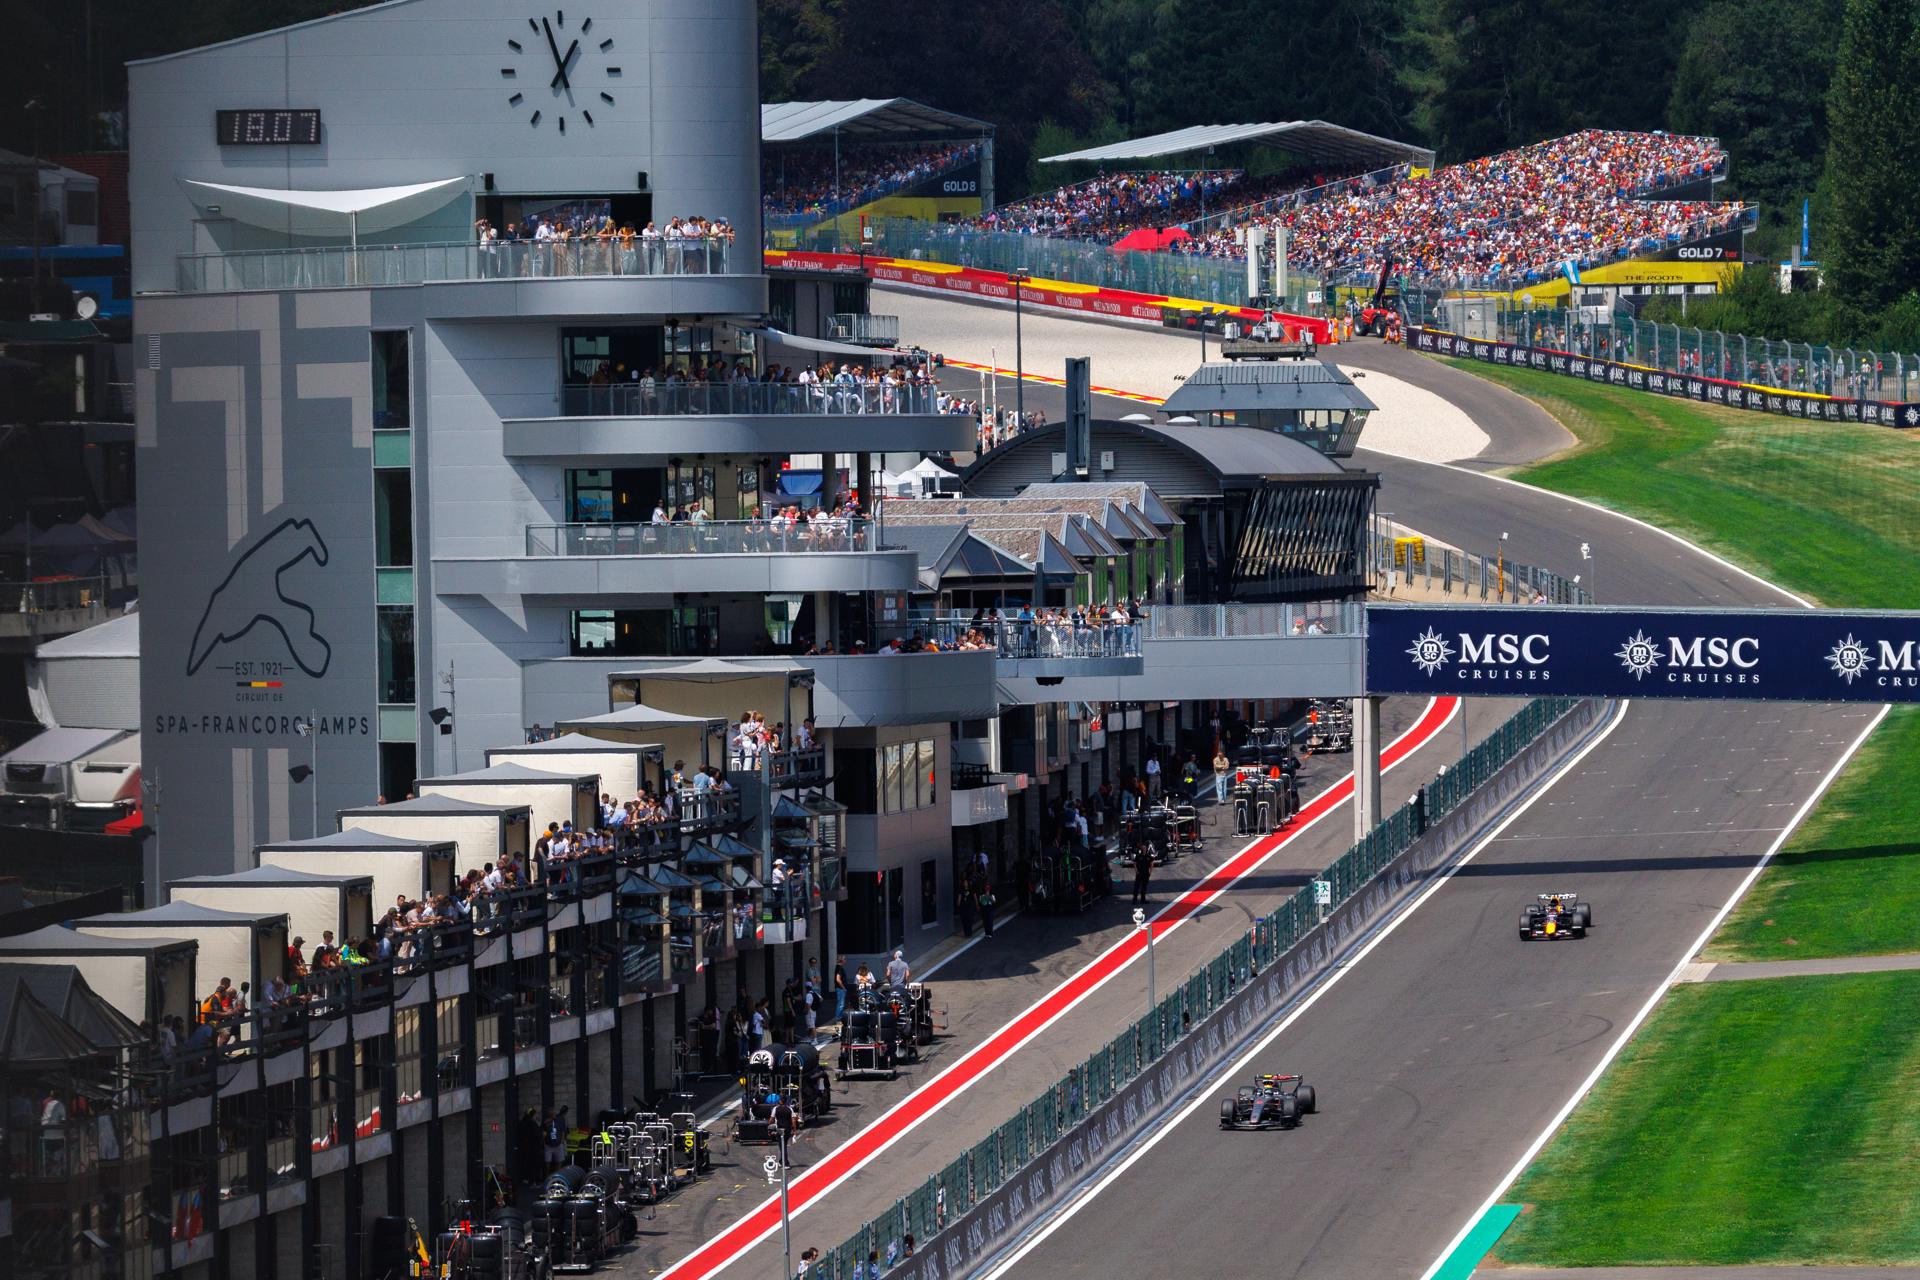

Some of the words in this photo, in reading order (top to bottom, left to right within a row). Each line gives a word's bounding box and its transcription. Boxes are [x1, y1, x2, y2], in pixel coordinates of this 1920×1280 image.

[233, 113, 317, 142] 18.07
[943, 181, 968, 192] GOLD
[969, 181, 976, 192] 8
[1678, 247, 1713, 259] GOLD
[1714, 247, 1723, 258] 7
[1422, 334, 1433, 346] MSC
[1442, 337, 1452, 349] MSC
[1460, 340, 1470, 352] MSC
[1498, 348, 1507, 358] MSC
[1516, 350, 1527, 362] MSC
[1536, 352, 1546, 365] MSC
[1555, 357, 1565, 369] MSC
[1575, 361, 1585, 373] MSC
[1594, 364, 1604, 376] MSC
[1615, 368, 1625, 380] MSC
[1653, 375, 1664, 388] MSC
[1672, 379, 1683, 390] MSC
[1712, 386, 1723, 398] MSC
[1731, 389, 1742, 401] MSC
[1752, 393, 1763, 404] MSC
[1791, 399, 1802, 411] MSC
[1458, 633, 1550, 664] MSC
[1668, 637, 1759, 668] MSC
[1878, 640, 1920, 671] M
[235, 662, 257, 675] EST.
[261, 662, 283, 675] 1921
[1458, 669, 1550, 680] CRUISES
[1668, 673, 1760, 683] CRUISES
[1878, 676, 1918, 686] CRU
[235, 692, 269, 702] CIRCUIT
[273, 693, 284, 702] DE
